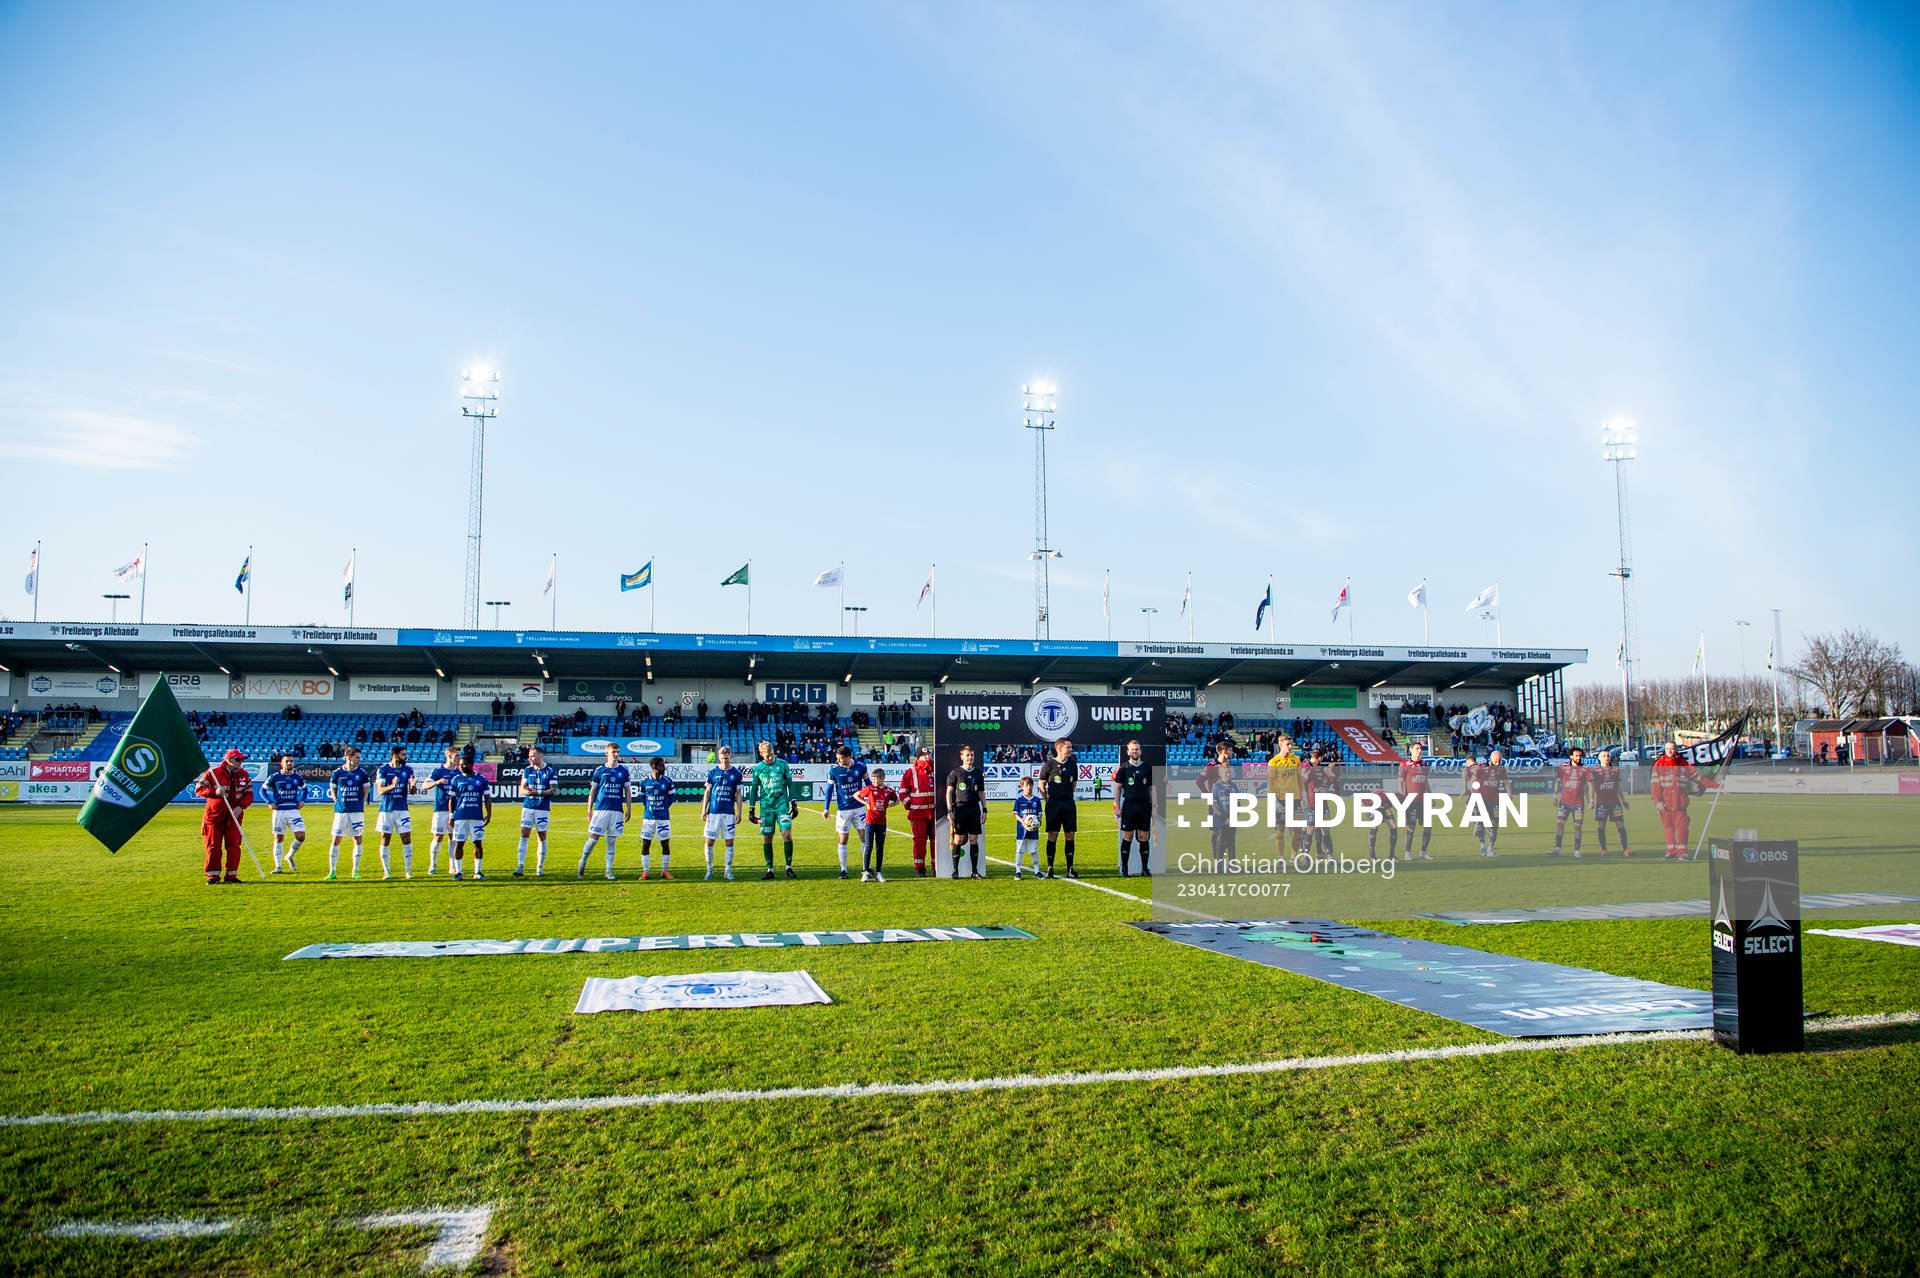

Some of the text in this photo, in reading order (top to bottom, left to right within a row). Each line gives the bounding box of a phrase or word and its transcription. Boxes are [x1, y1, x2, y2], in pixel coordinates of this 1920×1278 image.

[62, 626, 139, 637] Trelleborgs Allehanda
[173, 628, 257, 638] trelleborgsallehanda.se
[303, 630, 378, 640] Trelleborgs Allehanda
[1143, 645, 1204, 655] Trelleborgs Allehanda
[1230, 647, 1294, 656] trelleborgsallehanda.se
[1328, 648, 1384, 658] Trelleborgs Allehanda
[1408, 650, 1467, 659] trelleborgsallehanda.se
[1499, 650, 1551, 660] Trelleborgs Allehanda
[168, 675, 201, 686] GR8
[248, 680, 331, 696] KLARABO
[1168, 690, 1191, 700] ENSAM
[948, 706, 1012, 721] UNIBET
[1092, 707, 1154, 722] UNIBET
[558, 768, 594, 776] CRAFT
[28, 784, 58, 794] akea
[103, 783, 122, 801] OBOS
[1760, 851, 1788, 861] OBOS
[1713, 930, 1734, 954] SELECT
[1744, 936, 1794, 954] SELECT
